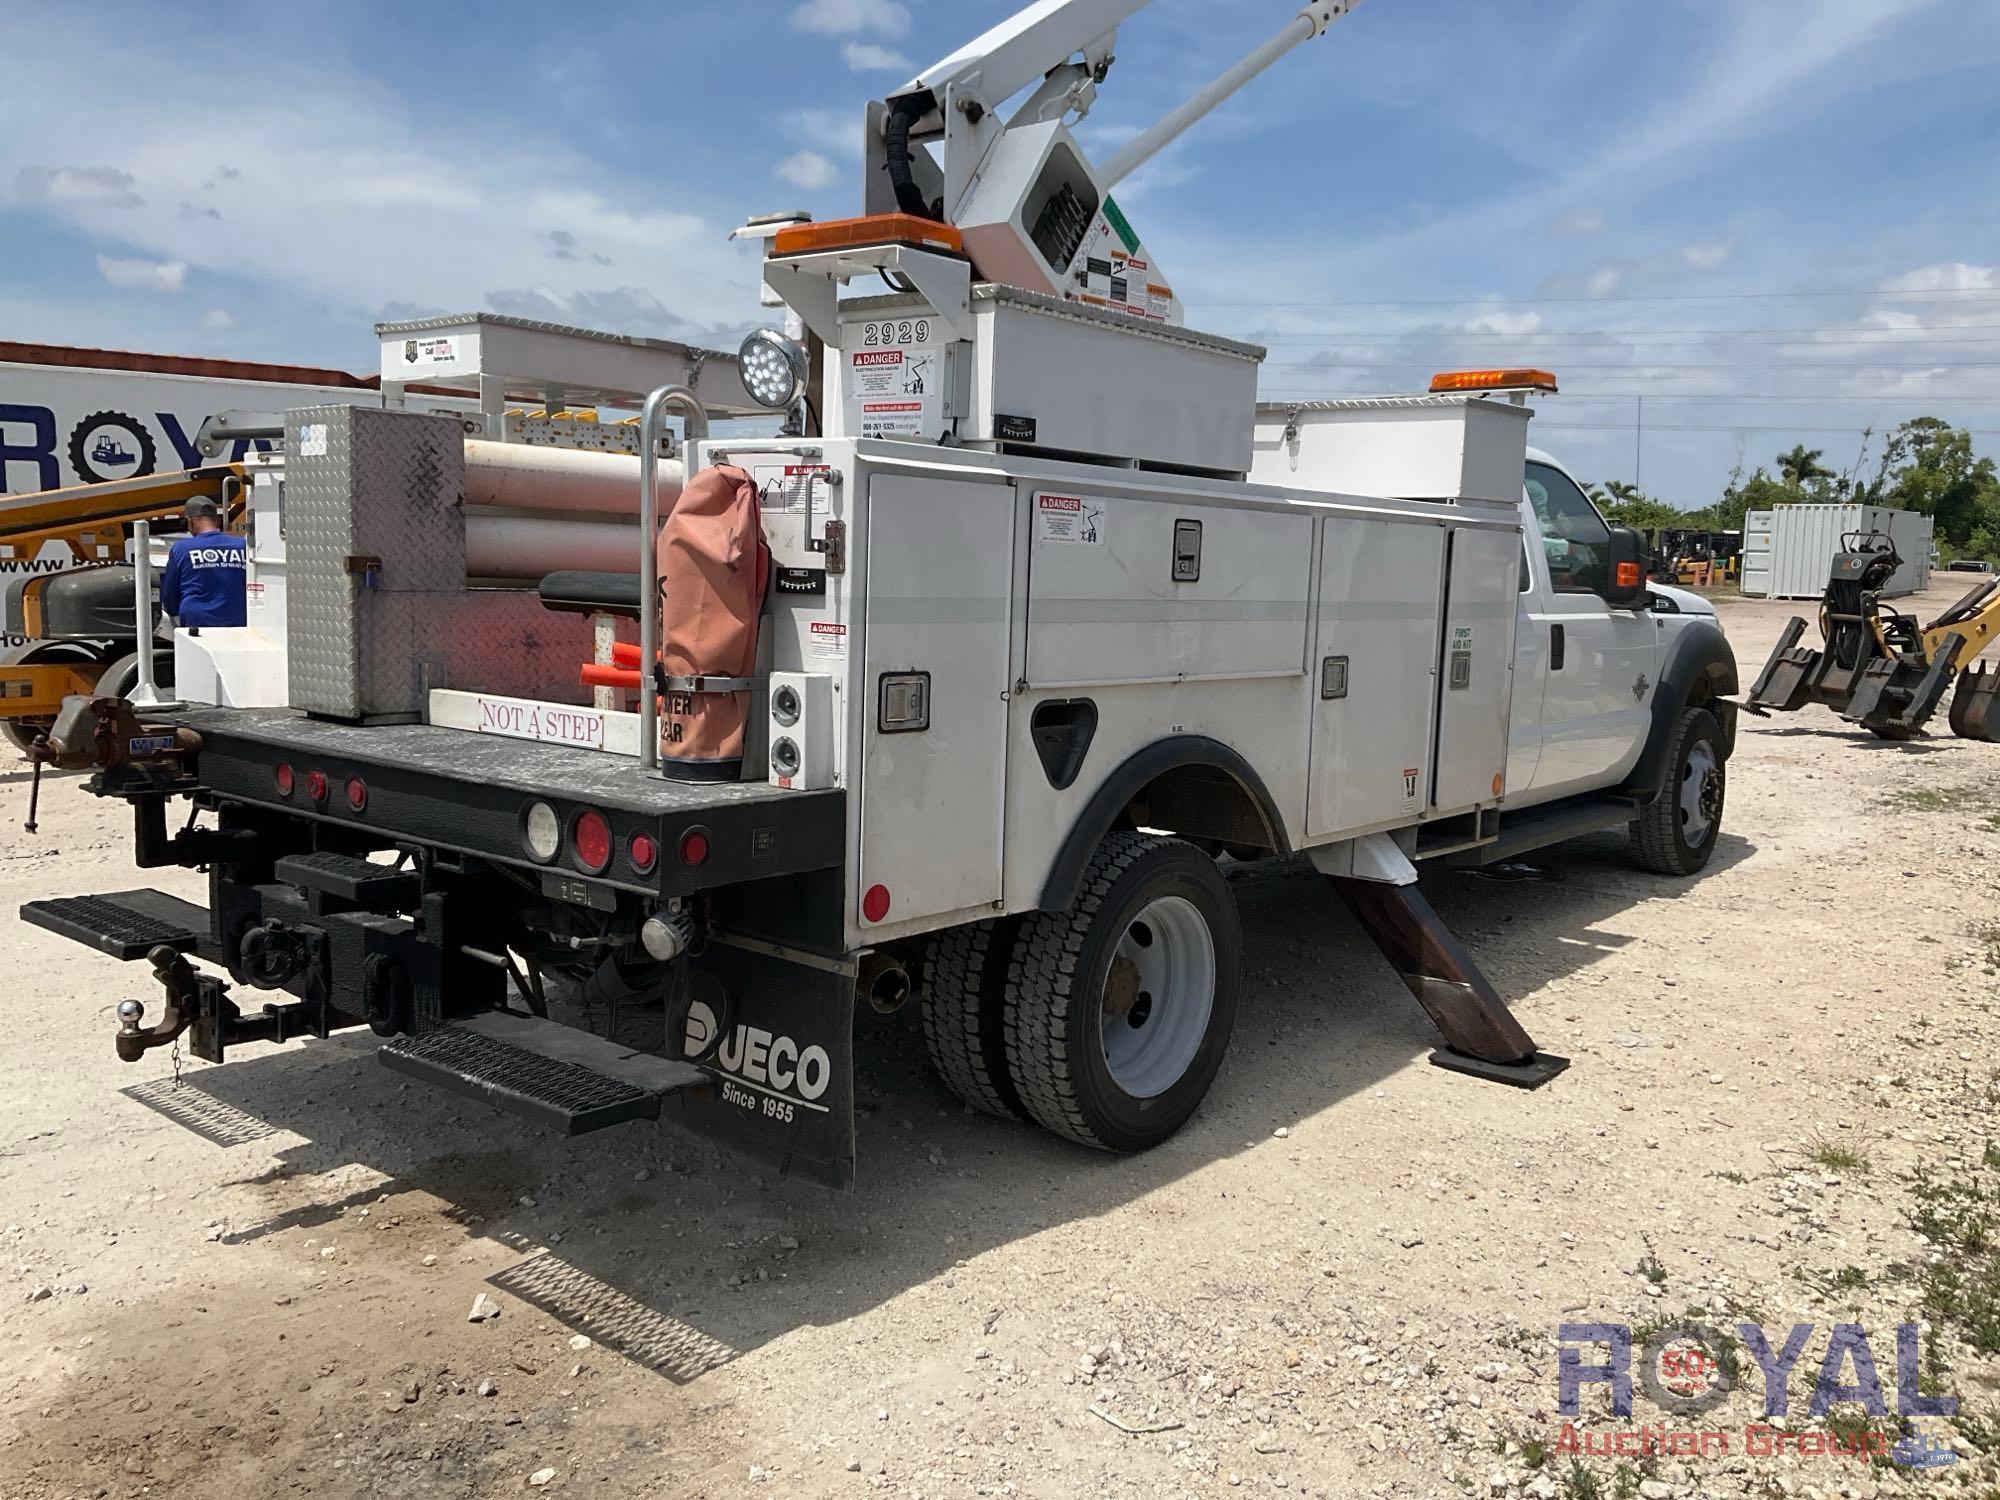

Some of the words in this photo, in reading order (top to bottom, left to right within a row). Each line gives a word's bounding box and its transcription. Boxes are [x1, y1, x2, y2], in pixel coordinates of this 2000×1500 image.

[864, 320, 930, 346] 2929
[863, 353, 900, 365] DANGER
[1048, 498, 1079, 510] DANGER
[817, 624, 845, 634] DANGER
[1454, 627, 1472, 638] FIRST
[1452, 639, 1462, 650] AID
[1462, 639, 1473, 649] KIT
[482, 702, 524, 731] NOT
[527, 709, 542, 735] A
[546, 711, 599, 742] STEP
[684, 1000, 831, 1100] DUECO
[721, 1081, 756, 1110] Since
[762, 1097, 794, 1123] 1955
